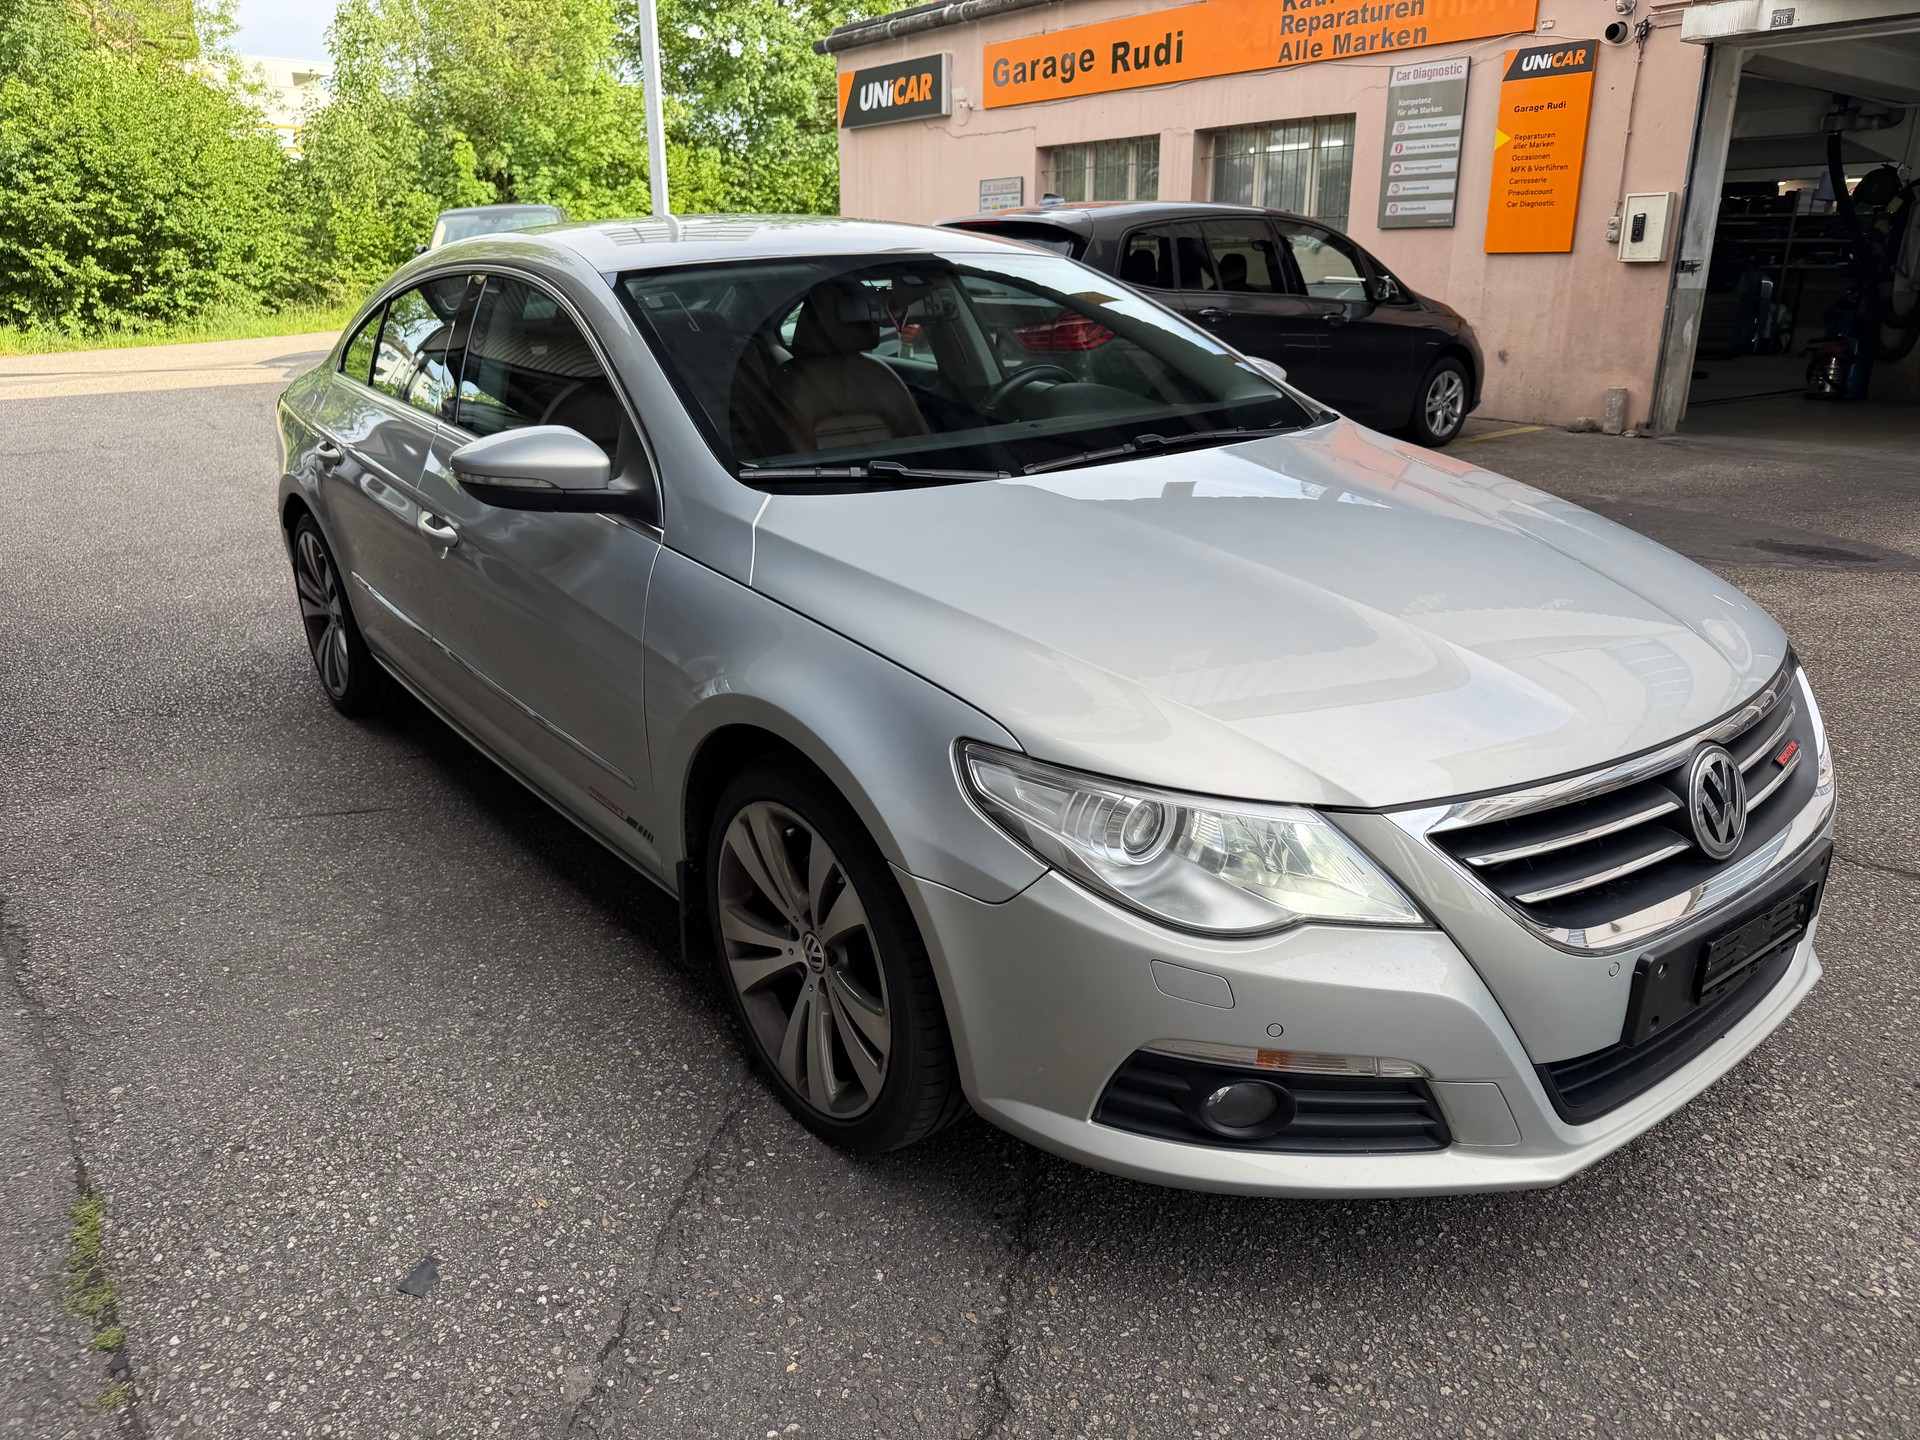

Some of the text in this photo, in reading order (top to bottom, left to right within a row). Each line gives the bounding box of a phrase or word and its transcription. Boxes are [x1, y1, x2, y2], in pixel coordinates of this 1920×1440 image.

[1280, 0, 1425, 37] Reparaturen
[1775, 15, 1788, 25] 516
[1278, 26, 1427, 63] Alle Marken
[993, 48, 1095, 88] Garage
[1111, 30, 1184, 75] Rudi
[1396, 62, 1463, 82] Car Diagnostic
[1398, 97, 1432, 107] Kompetenz
[1513, 101, 1567, 113] Garage Rudi
[1397, 105, 1443, 116] für alle Marken
[1427, 122, 1448, 130] Reparatur
[1514, 132, 1556, 142] Reparaturen
[1513, 141, 1555, 150] aller Marken
[1511, 153, 1551, 162] Occasionen
[1510, 165, 1526, 173] MFK
[1534, 163, 1569, 172] Vorführen
[1509, 176, 1548, 185] Carrosserie
[1507, 188, 1554, 197] Pneudiscount
[1506, 199, 1556, 209] Car Diagnostic
